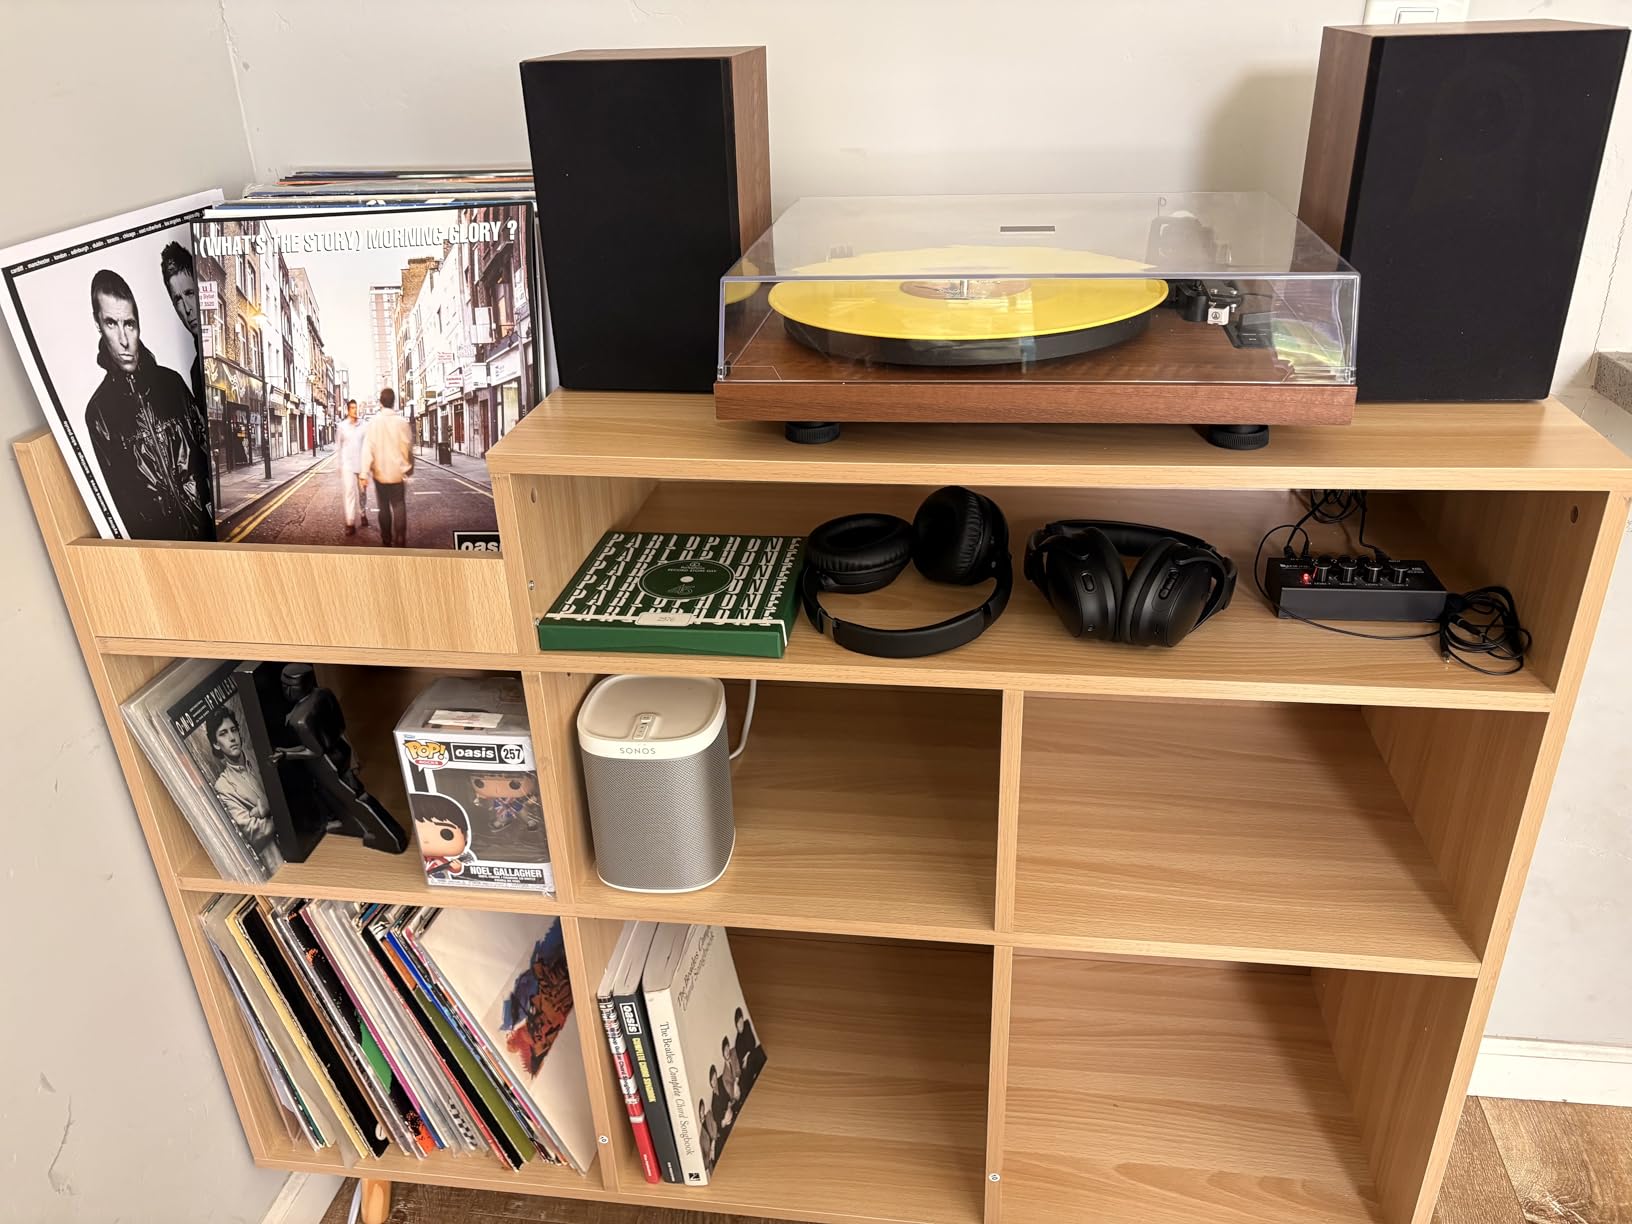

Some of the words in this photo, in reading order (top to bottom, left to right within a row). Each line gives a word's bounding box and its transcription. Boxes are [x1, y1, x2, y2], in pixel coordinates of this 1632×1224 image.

[199, 234, 266, 258] (WHAT'S
[272, 233, 300, 255] THE
[303, 229, 361, 253] STORY)
[366, 225, 443, 250] MORNING
[448, 221, 502, 244] GLORY
[506, 220, 518, 241] ?
[461, 541, 501, 551] oas
[604, 533, 802, 552] PARLOPHONE
[403, 740, 446, 760] POP!
[455, 747, 495, 758] oasis
[502, 748, 521, 760] 257
[619, 747, 656, 755] SONOS
[470, 866, 491, 875] NOEL
[493, 867, 543, 878] GALLAGHER
[622, 1005, 638, 1033] oasis
[660, 1021, 670, 1038] The
[663, 1038, 674, 1064] Beatles
[668, 1066, 682, 1097] Complete
[675, 1098, 686, 1119] Chord
[679, 1120, 695, 1156] Songbook
